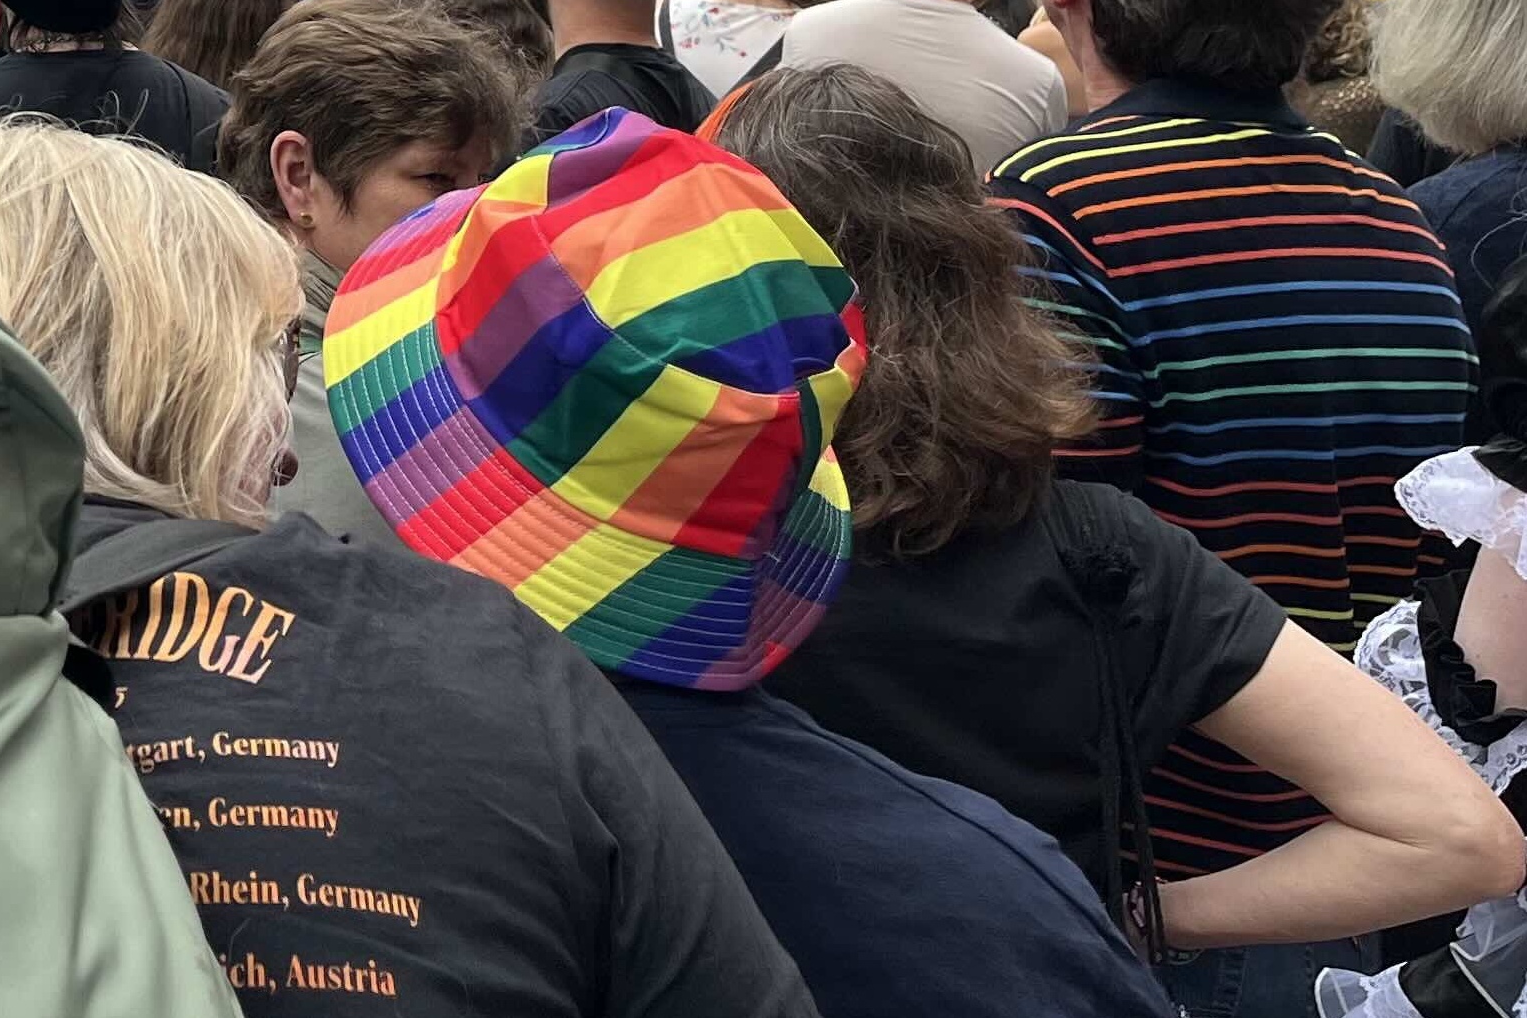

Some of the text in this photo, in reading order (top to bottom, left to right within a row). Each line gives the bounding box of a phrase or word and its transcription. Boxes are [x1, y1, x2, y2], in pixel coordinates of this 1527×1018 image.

[95, 571, 296, 684] RIDGE
[125, 731, 340, 774] tgart, Germany
[208, 797, 339, 837] Germany
[190, 870, 421, 928] Rhein, Germany
[219, 953, 397, 997] ich, Austria
